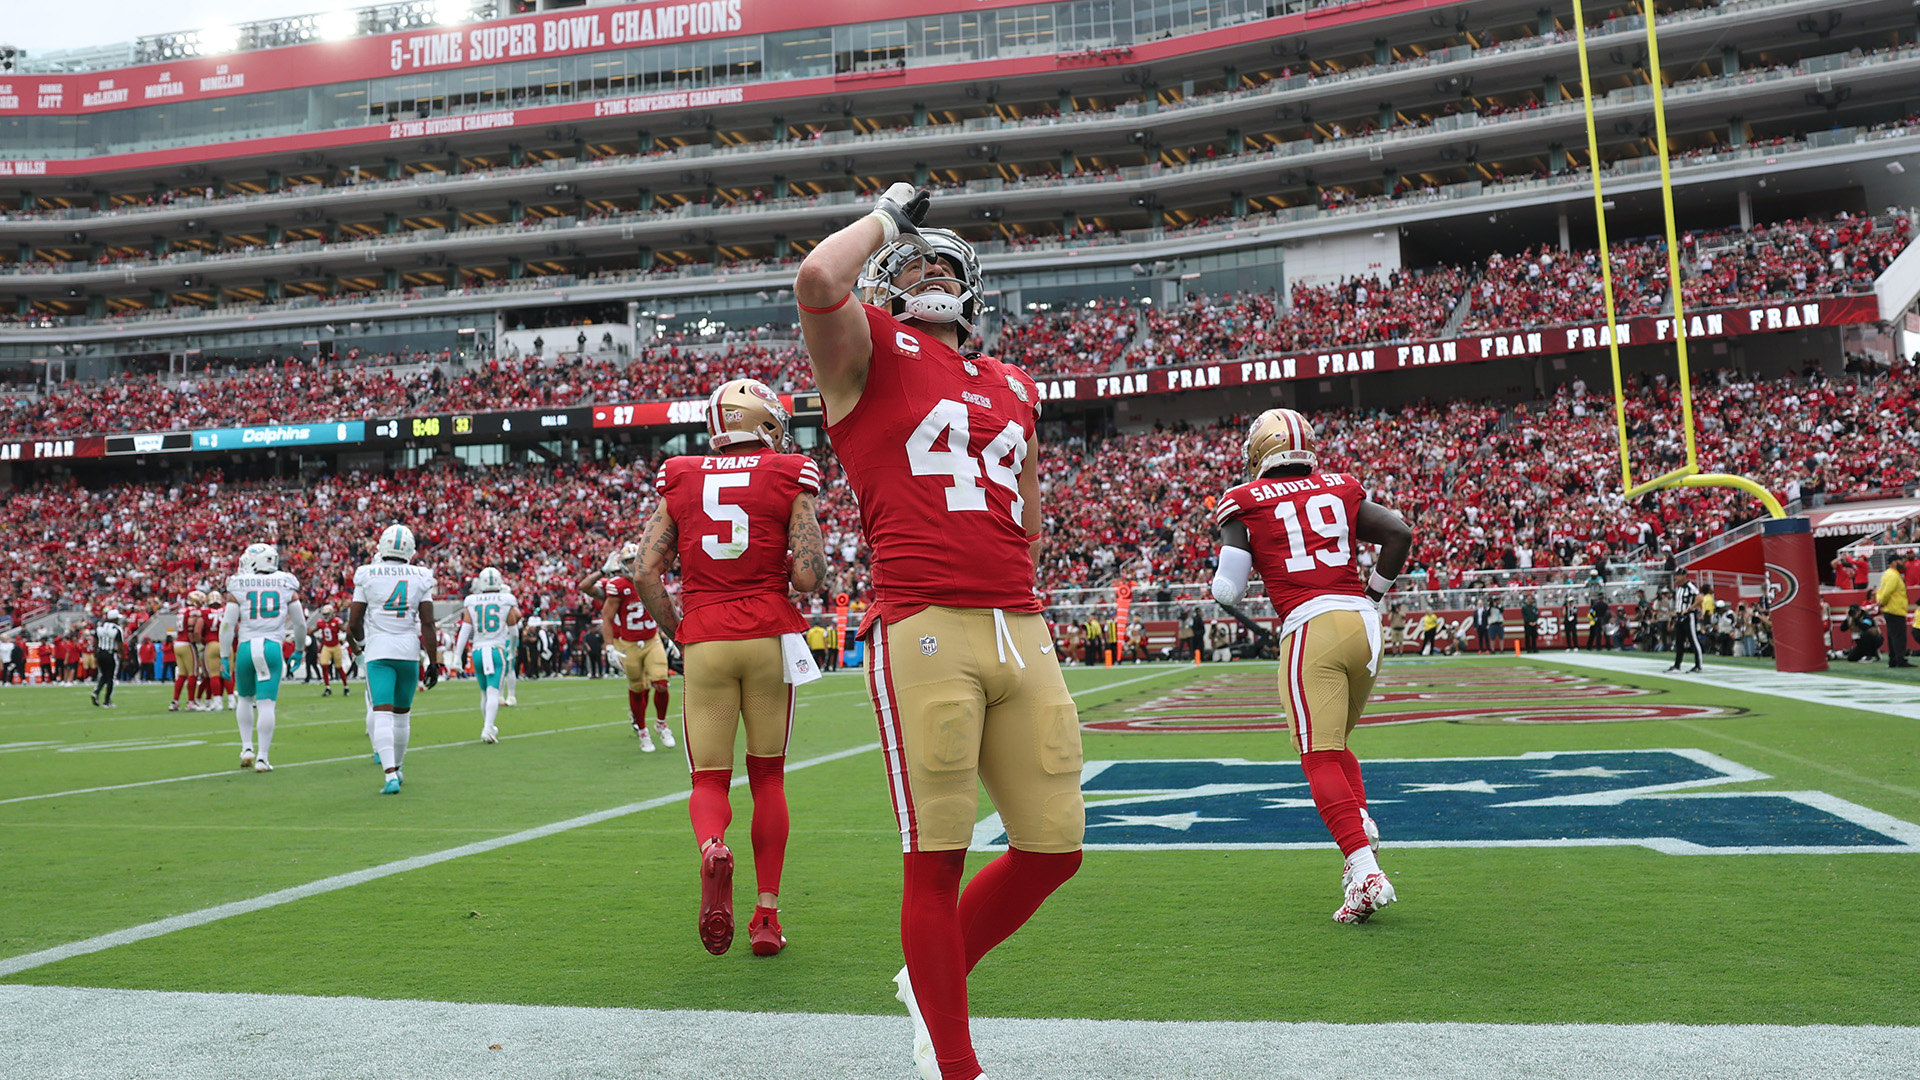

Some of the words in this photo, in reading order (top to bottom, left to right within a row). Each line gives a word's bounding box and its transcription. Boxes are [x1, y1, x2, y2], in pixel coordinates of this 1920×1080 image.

[390, 32, 462, 71] 5-TIME
[470, 22, 537, 62] SUPER
[543, 14, 605, 53] BOWL
[611, 0, 743, 44] CHAMPIONS
[145, 81, 184, 99] MONTANA
[628, 94, 687, 114] CONFERENCE
[688, 88, 743, 108] CHAMPIONS
[37, 95, 63, 108] LOTT
[390, 121, 424, 138] 22-TIME
[425, 117, 463, 136] DIVISION
[464, 112, 514, 131] CHAMPIONS
[15, 161, 46, 174] WALSH
[895, 331, 920, 353] C
[1096, 374, 1148, 397] FRAN
[1167, 366, 1221, 390] FRAN
[1241, 358, 1297, 382] FRAN
[1317, 350, 1375, 375] FRAN
[1397, 341, 1457, 367] FRAN
[1480, 332, 1542, 358] FRAN
[1566, 323, 1631, 350] FRAN
[1749, 303, 1820, 331] FRAN
[613, 406, 635, 425] 27
[667, 400, 708, 424] 49E
[211, 434, 218, 448] 3
[242, 428, 311, 444] Dolphins
[389, 420, 398, 439] 3
[412, 417, 440, 437] 5:46
[34, 440, 75, 458] FRAN
[701, 455, 761, 470] EVANS
[905, 399, 1028, 528] 44
[1250, 478, 1321, 502] SAMUEL
[1321, 473, 1346, 487] SR
[701, 472, 750, 560] 5
[1274, 493, 1351, 573] 19
[369, 566, 423, 577] MARSHALL
[239, 578, 289, 588] RODRIGUEZ
[246, 590, 280, 620] 10
[383, 579, 410, 618] 4
[475, 603, 500, 633] 16
[1536, 617, 1559, 636] 35
[324, 629, 333, 642] 9
